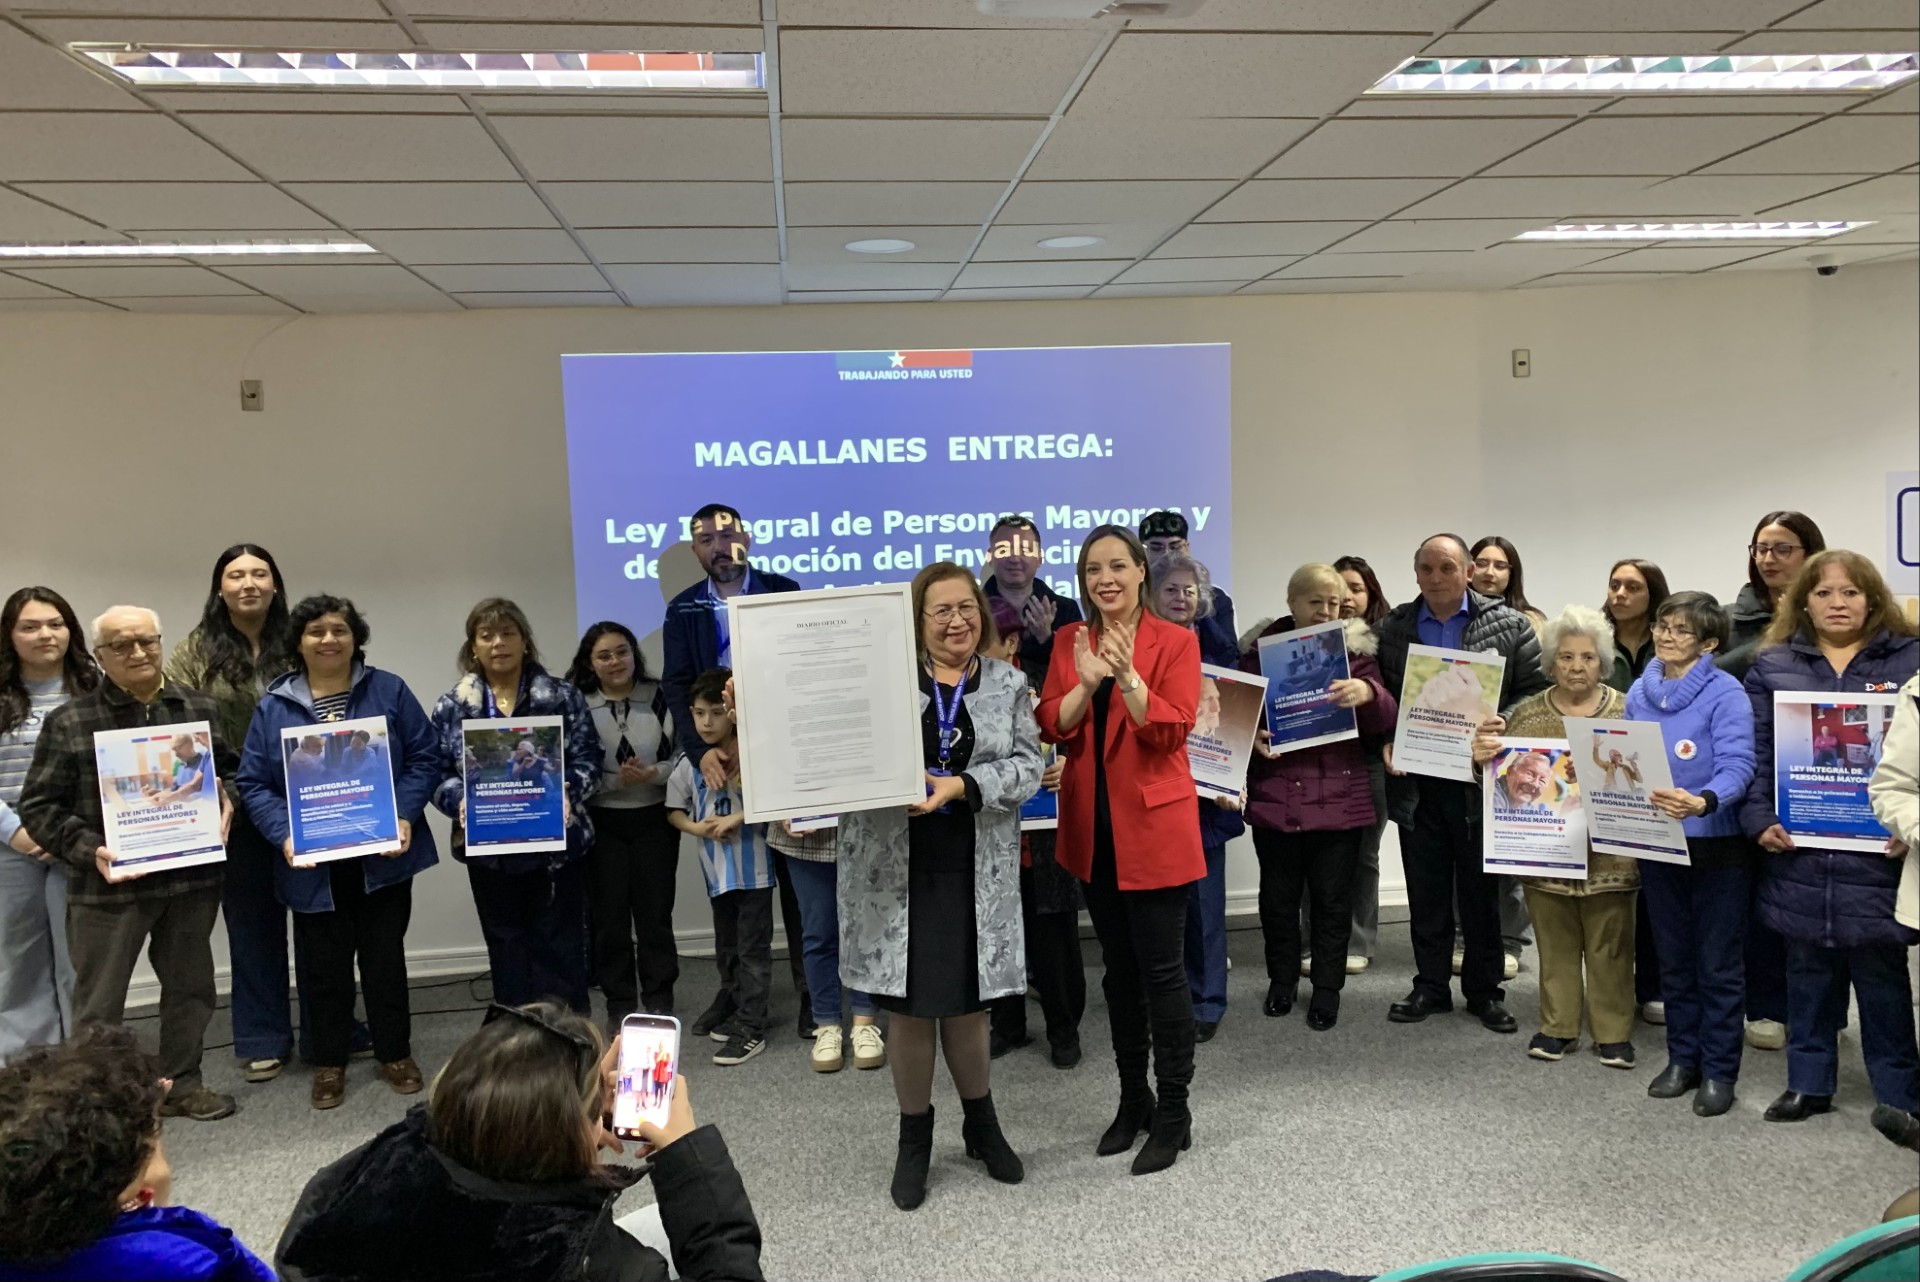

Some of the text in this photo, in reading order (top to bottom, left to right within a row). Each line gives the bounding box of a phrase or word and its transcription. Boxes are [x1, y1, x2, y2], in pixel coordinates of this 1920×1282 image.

[838, 369, 972, 381] TRABAJANDO PARA USTED
[695, 433, 1114, 467] MAGALLANES ENTREGA:
[606, 518, 667, 548] Ley
[831, 510, 872, 537] de
[1192, 506, 1211, 532] y
[873, 543, 922, 571] del
[796, 621, 821, 629] DIARIO
[822, 619, 848, 627] OFICIAL
[1275, 696, 1286, 704] LEY
[1286, 690, 1315, 701] INTEGRAL
[1275, 699, 1306, 710] PERSONAS
[1423, 708, 1456, 718] INTEGRAL
[1409, 714, 1476, 728] PERSONAS MAYORES
[1203, 744, 1233, 756] MAYORES
[1806, 765, 1850, 774] INTEGRAL
[1851, 767, 1863, 775] DE
[1790, 773, 1835, 782] PERSONAS
[314, 781, 350, 791] INTEGRAL
[489, 781, 523, 789] INTEGRAL
[300, 785, 374, 801] PERSONAS MAYORES
[476, 787, 546, 797] PERSONAS MAYORES
[1589, 790, 1601, 798] LEY
[1602, 792, 1635, 801] INTEGRAL
[1591, 798, 1626, 808] PERSONAS
[117, 811, 131, 819] LEY
[132, 806, 172, 817] INTEGRAL
[1509, 808, 1543, 816] INTEGRAL
[117, 810, 198, 826] PERSONAS MAYORES
[1494, 815, 1566, 825] PERSONAS MAYORES
